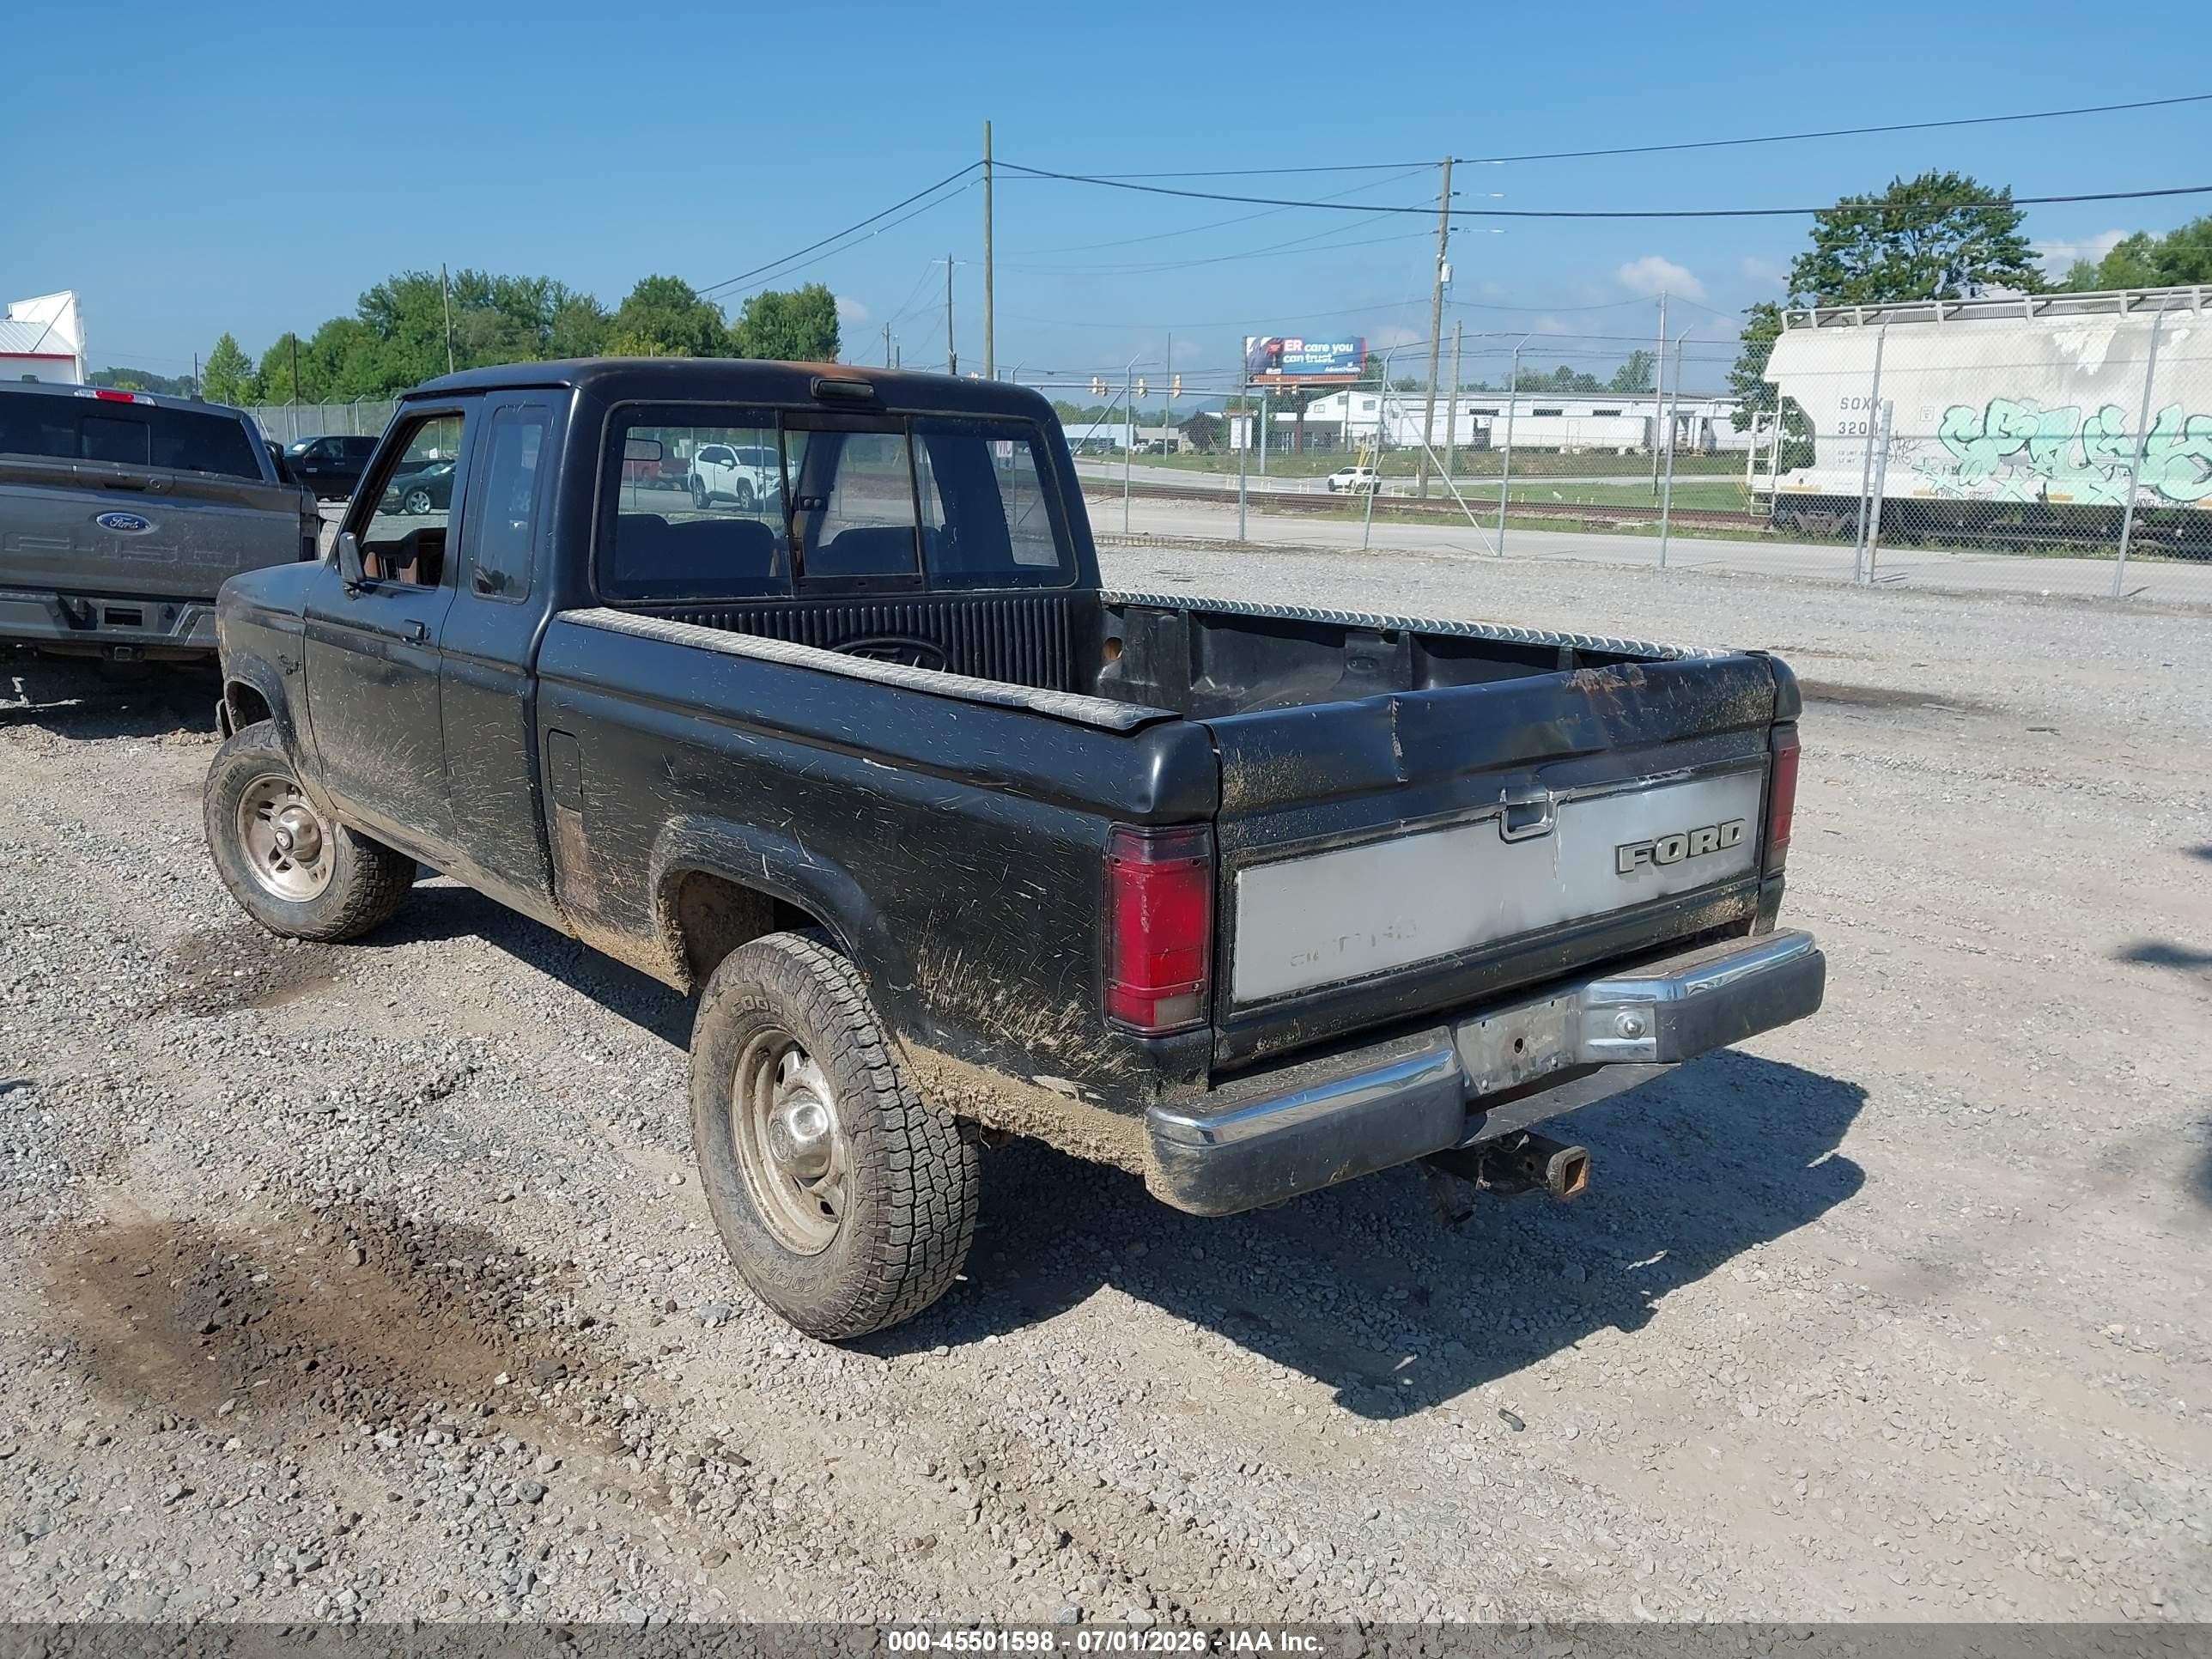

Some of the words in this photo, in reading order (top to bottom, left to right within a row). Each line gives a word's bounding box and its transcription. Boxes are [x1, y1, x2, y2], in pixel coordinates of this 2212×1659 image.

[1284, 339, 1303, 351] ER
[1304, 343, 1329, 352] care
[1332, 343, 1354, 355] you
[1283, 354, 1304, 363] can
[1305, 353, 1335, 363] trust.
[109, 516, 139, 528] Ford
[1615, 818, 1746, 874] FORD
